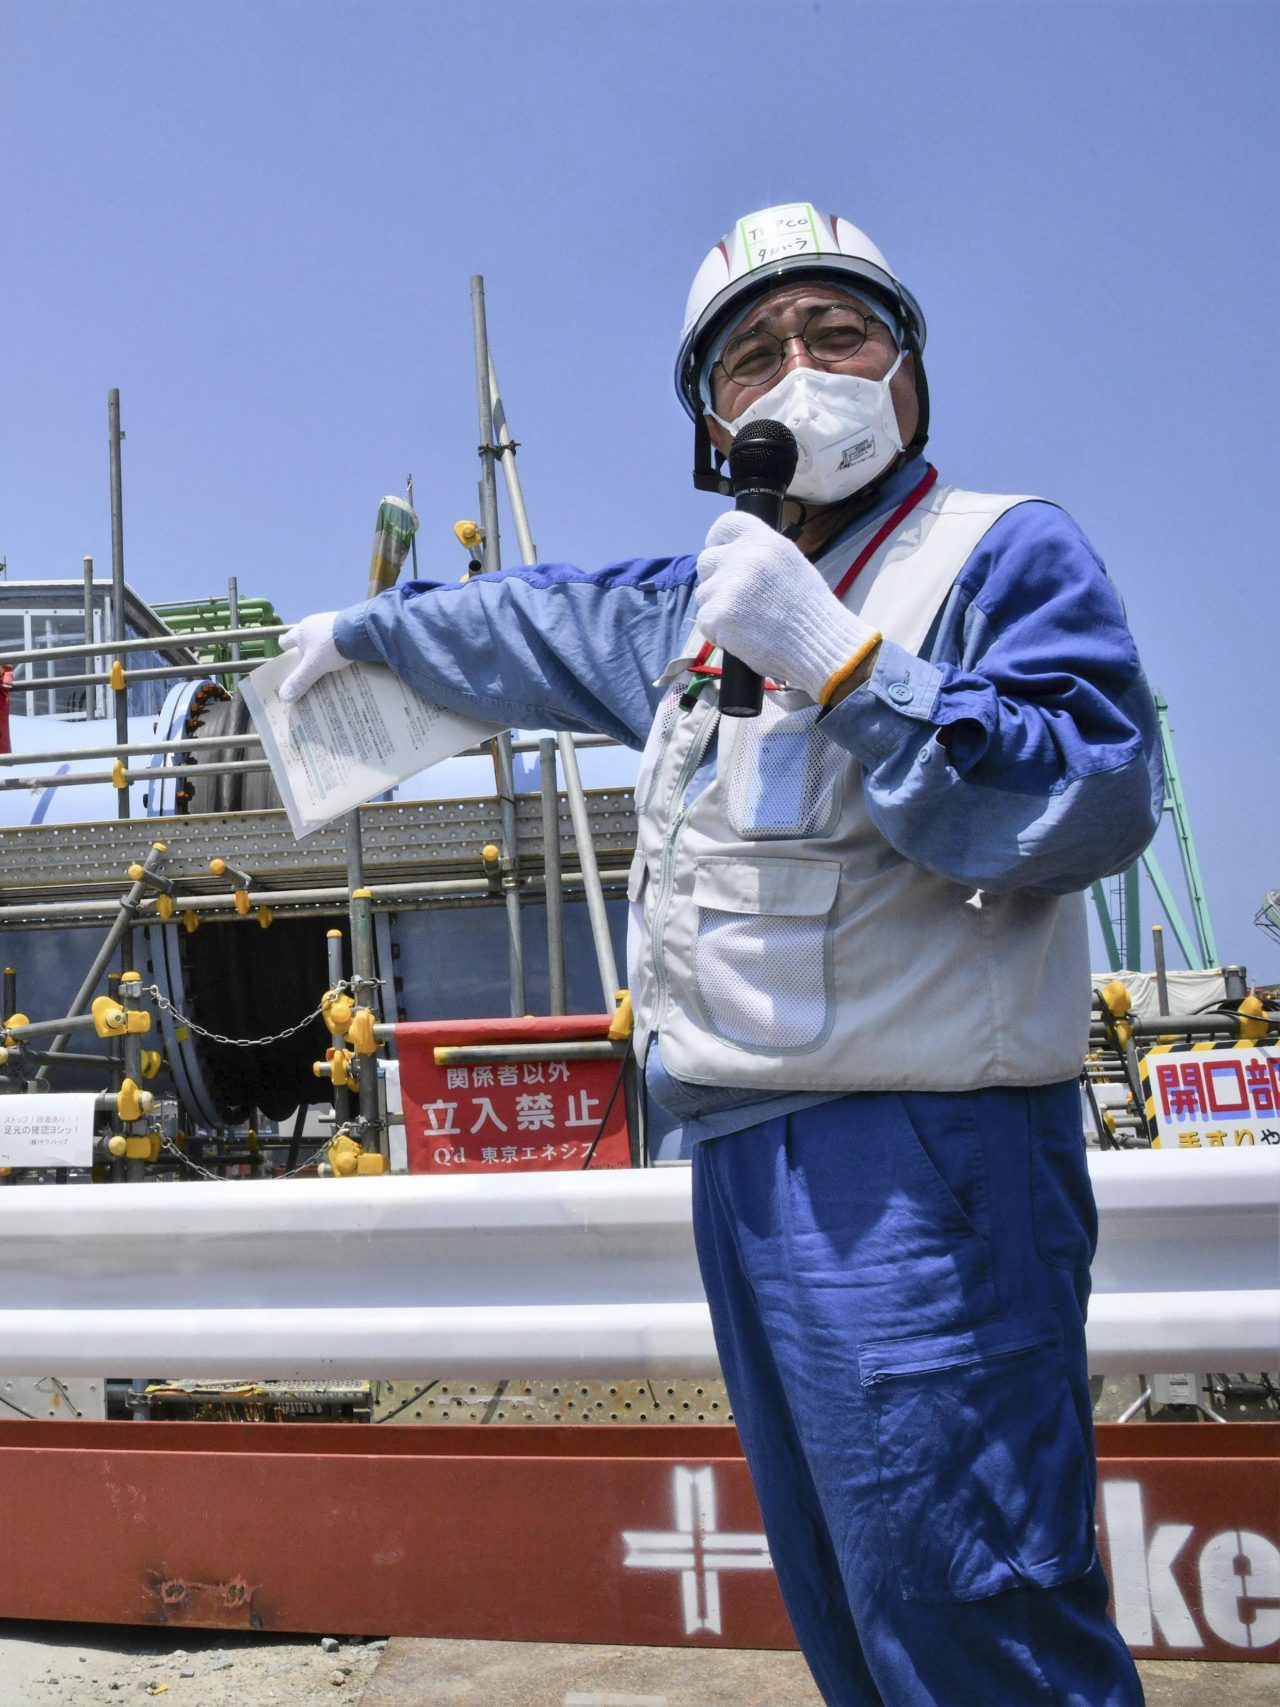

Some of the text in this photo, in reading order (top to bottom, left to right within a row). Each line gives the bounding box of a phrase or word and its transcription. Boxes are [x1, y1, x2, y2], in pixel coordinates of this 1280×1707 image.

[748, 218, 809, 241] TPCO
[446, 1061, 570, 1090] 関係者以外
[1156, 1058, 1280, 1121] 開口部
[422, 1089, 603, 1136] 立入禁止
[481, 1142, 598, 1165] 東京エネシス
[1095, 1480, 1280, 1648] ke
